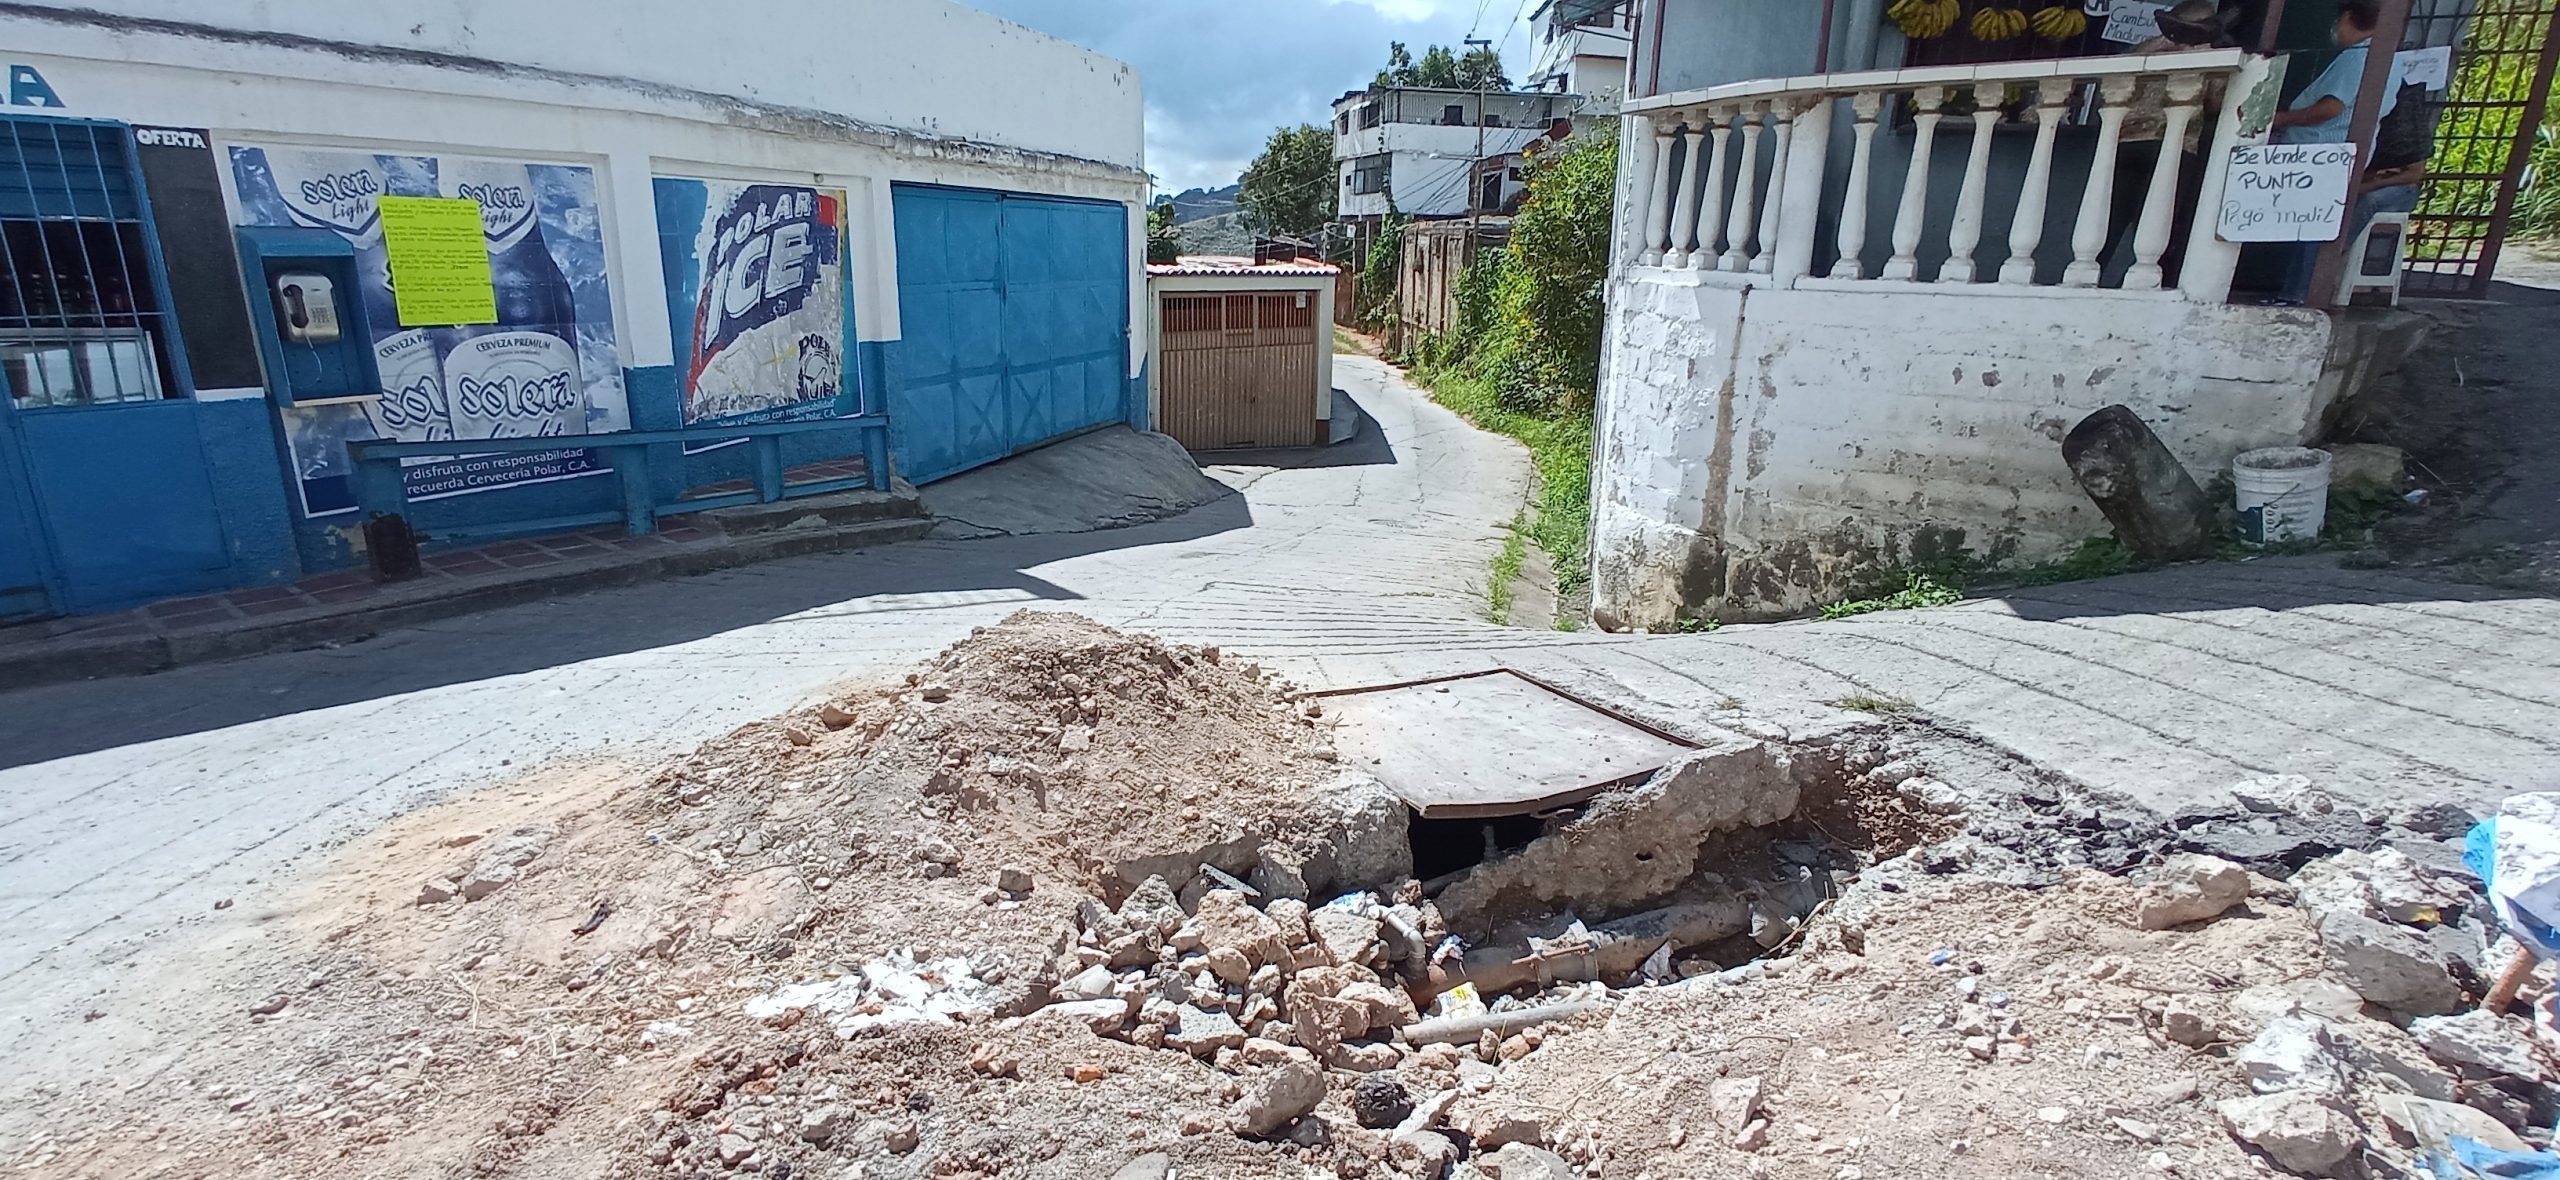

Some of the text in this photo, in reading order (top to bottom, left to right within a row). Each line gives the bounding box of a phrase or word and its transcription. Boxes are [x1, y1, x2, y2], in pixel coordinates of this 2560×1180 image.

[2110, 6, 2156, 28] Cambu
[136, 129, 207, 149] OFERTA
[2234, 147, 2259, 165] Se
[2264, 145, 2308, 165] Vende
[2238, 171, 2314, 190] PUNTO
[332, 198, 370, 223] Light
[717, 191, 813, 265] POLAR
[379, 335, 418, 358] CERVEZA
[476, 336, 551, 353] CERVEZA PREMIUM
[407, 477, 465, 495] recuerda
[467, 466, 531, 486] Cervecería
[533, 464, 565, 476] Polar,
[413, 462, 464, 480] disfruta
[466, 460, 490, 473] con
